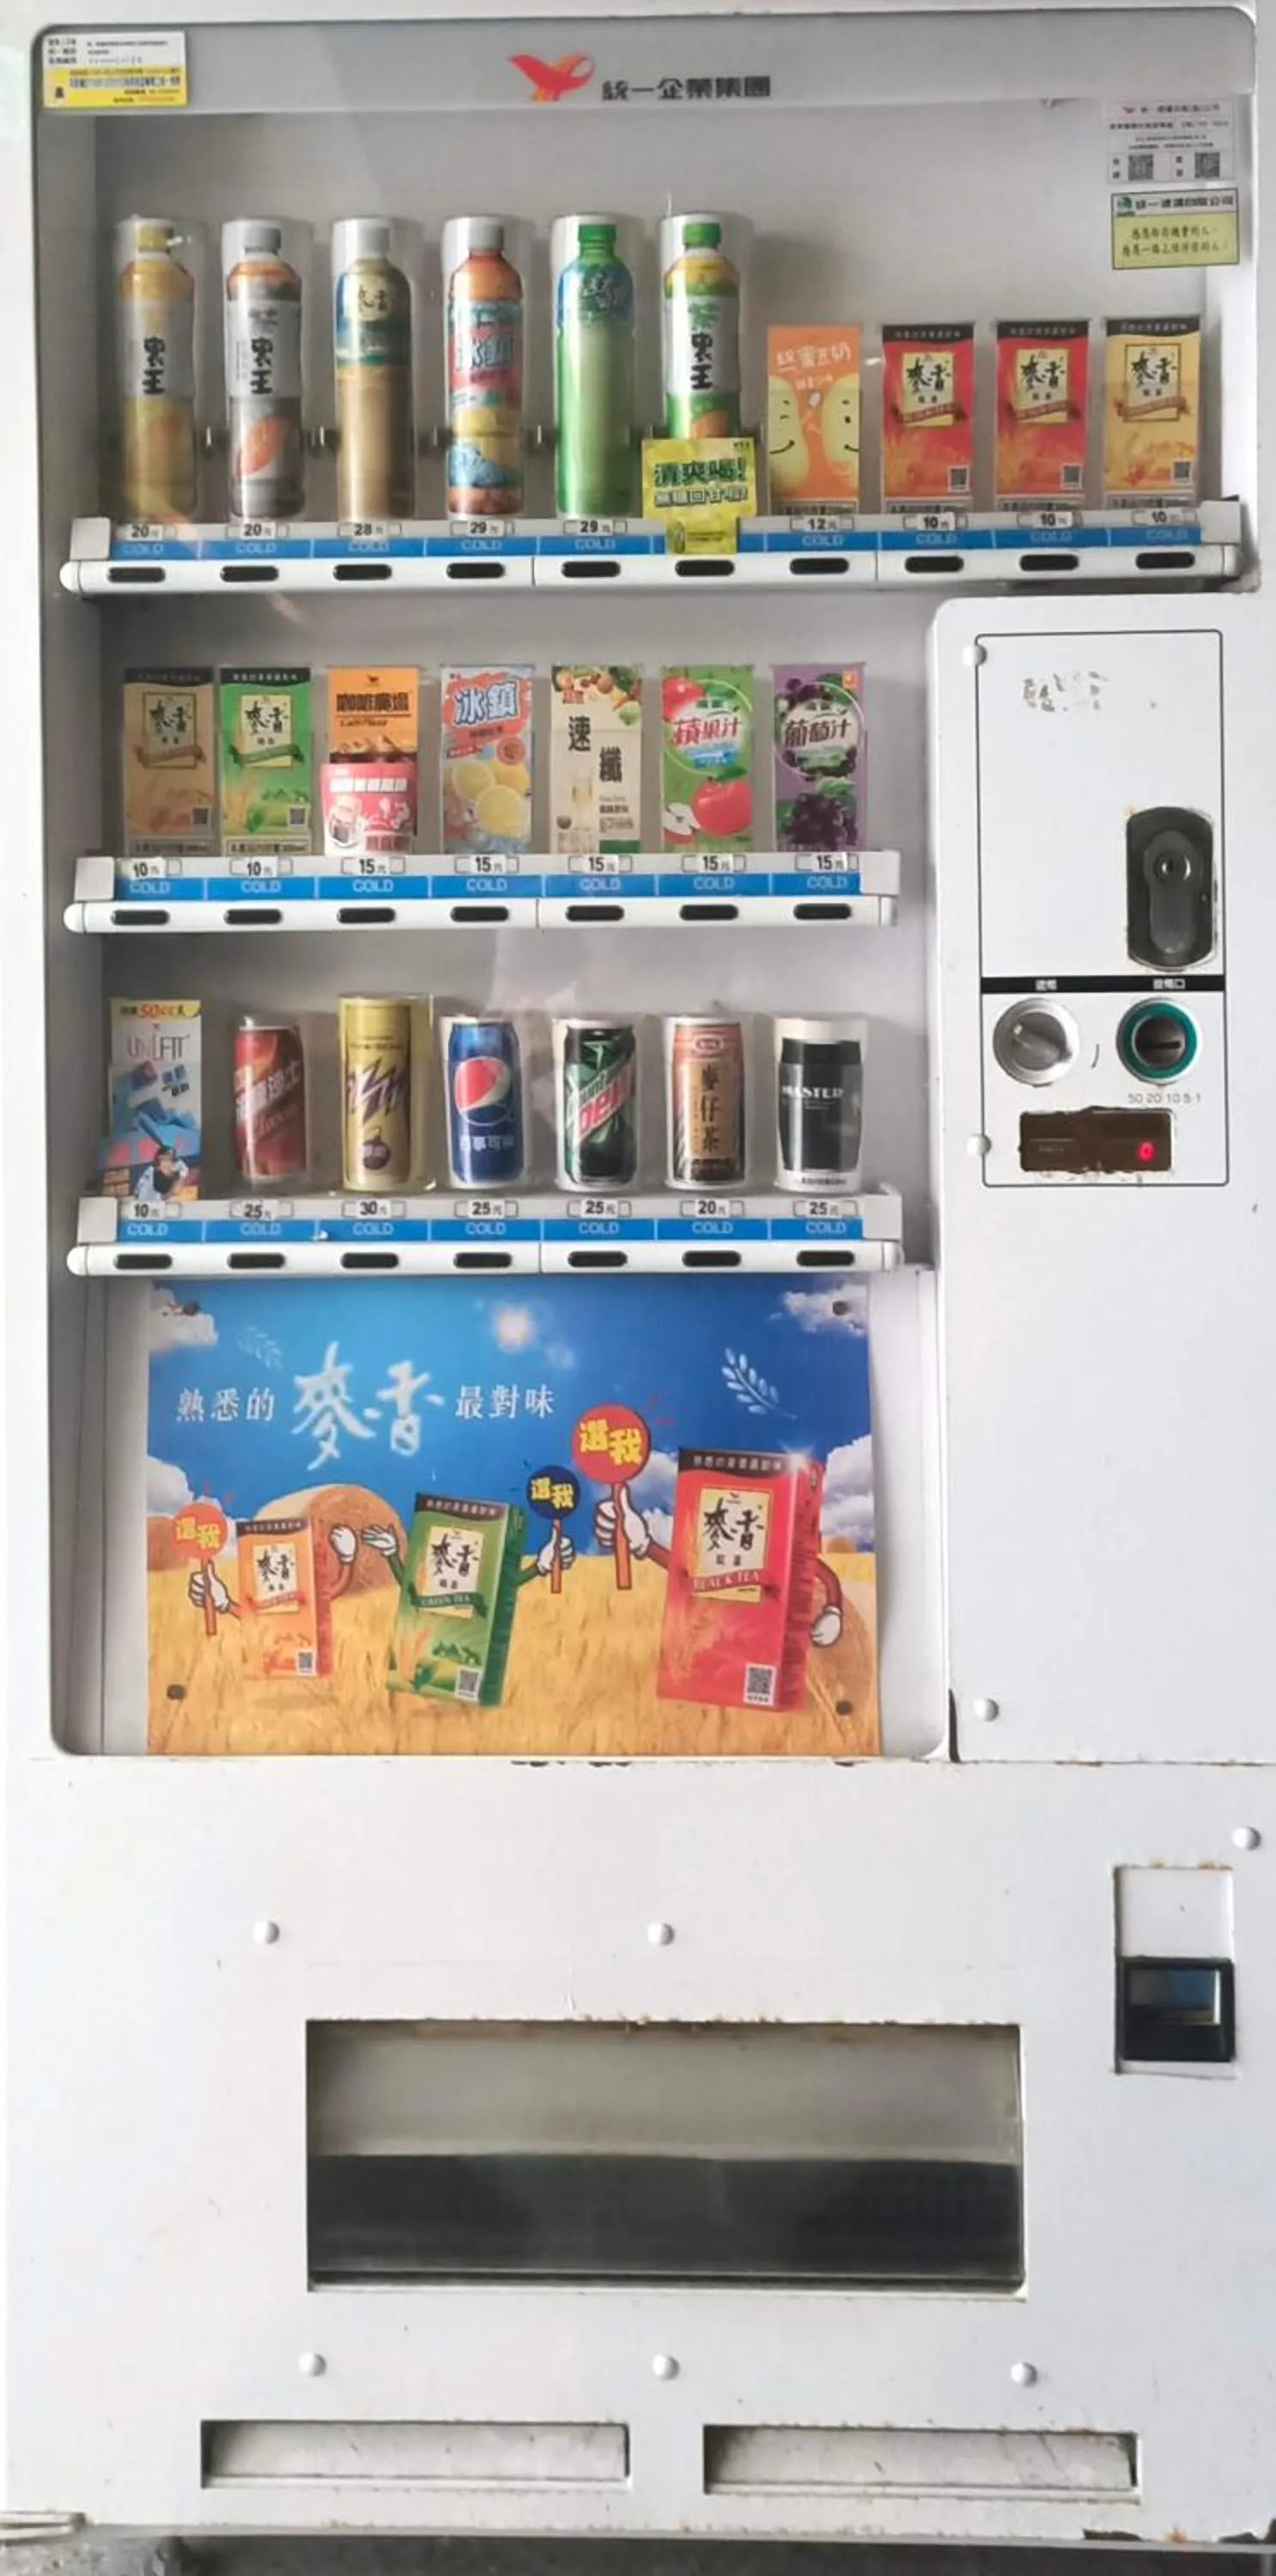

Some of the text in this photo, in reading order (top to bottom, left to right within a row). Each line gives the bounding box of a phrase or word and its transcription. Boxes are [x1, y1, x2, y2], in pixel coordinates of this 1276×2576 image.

[175, 1340, 556, 1472] 熟悉的 麥香 最對味
[580, 1419, 642, 1466] 選我
[531, 1477, 574, 1510] 選我
[702, 1497, 765, 1553] 麥香
